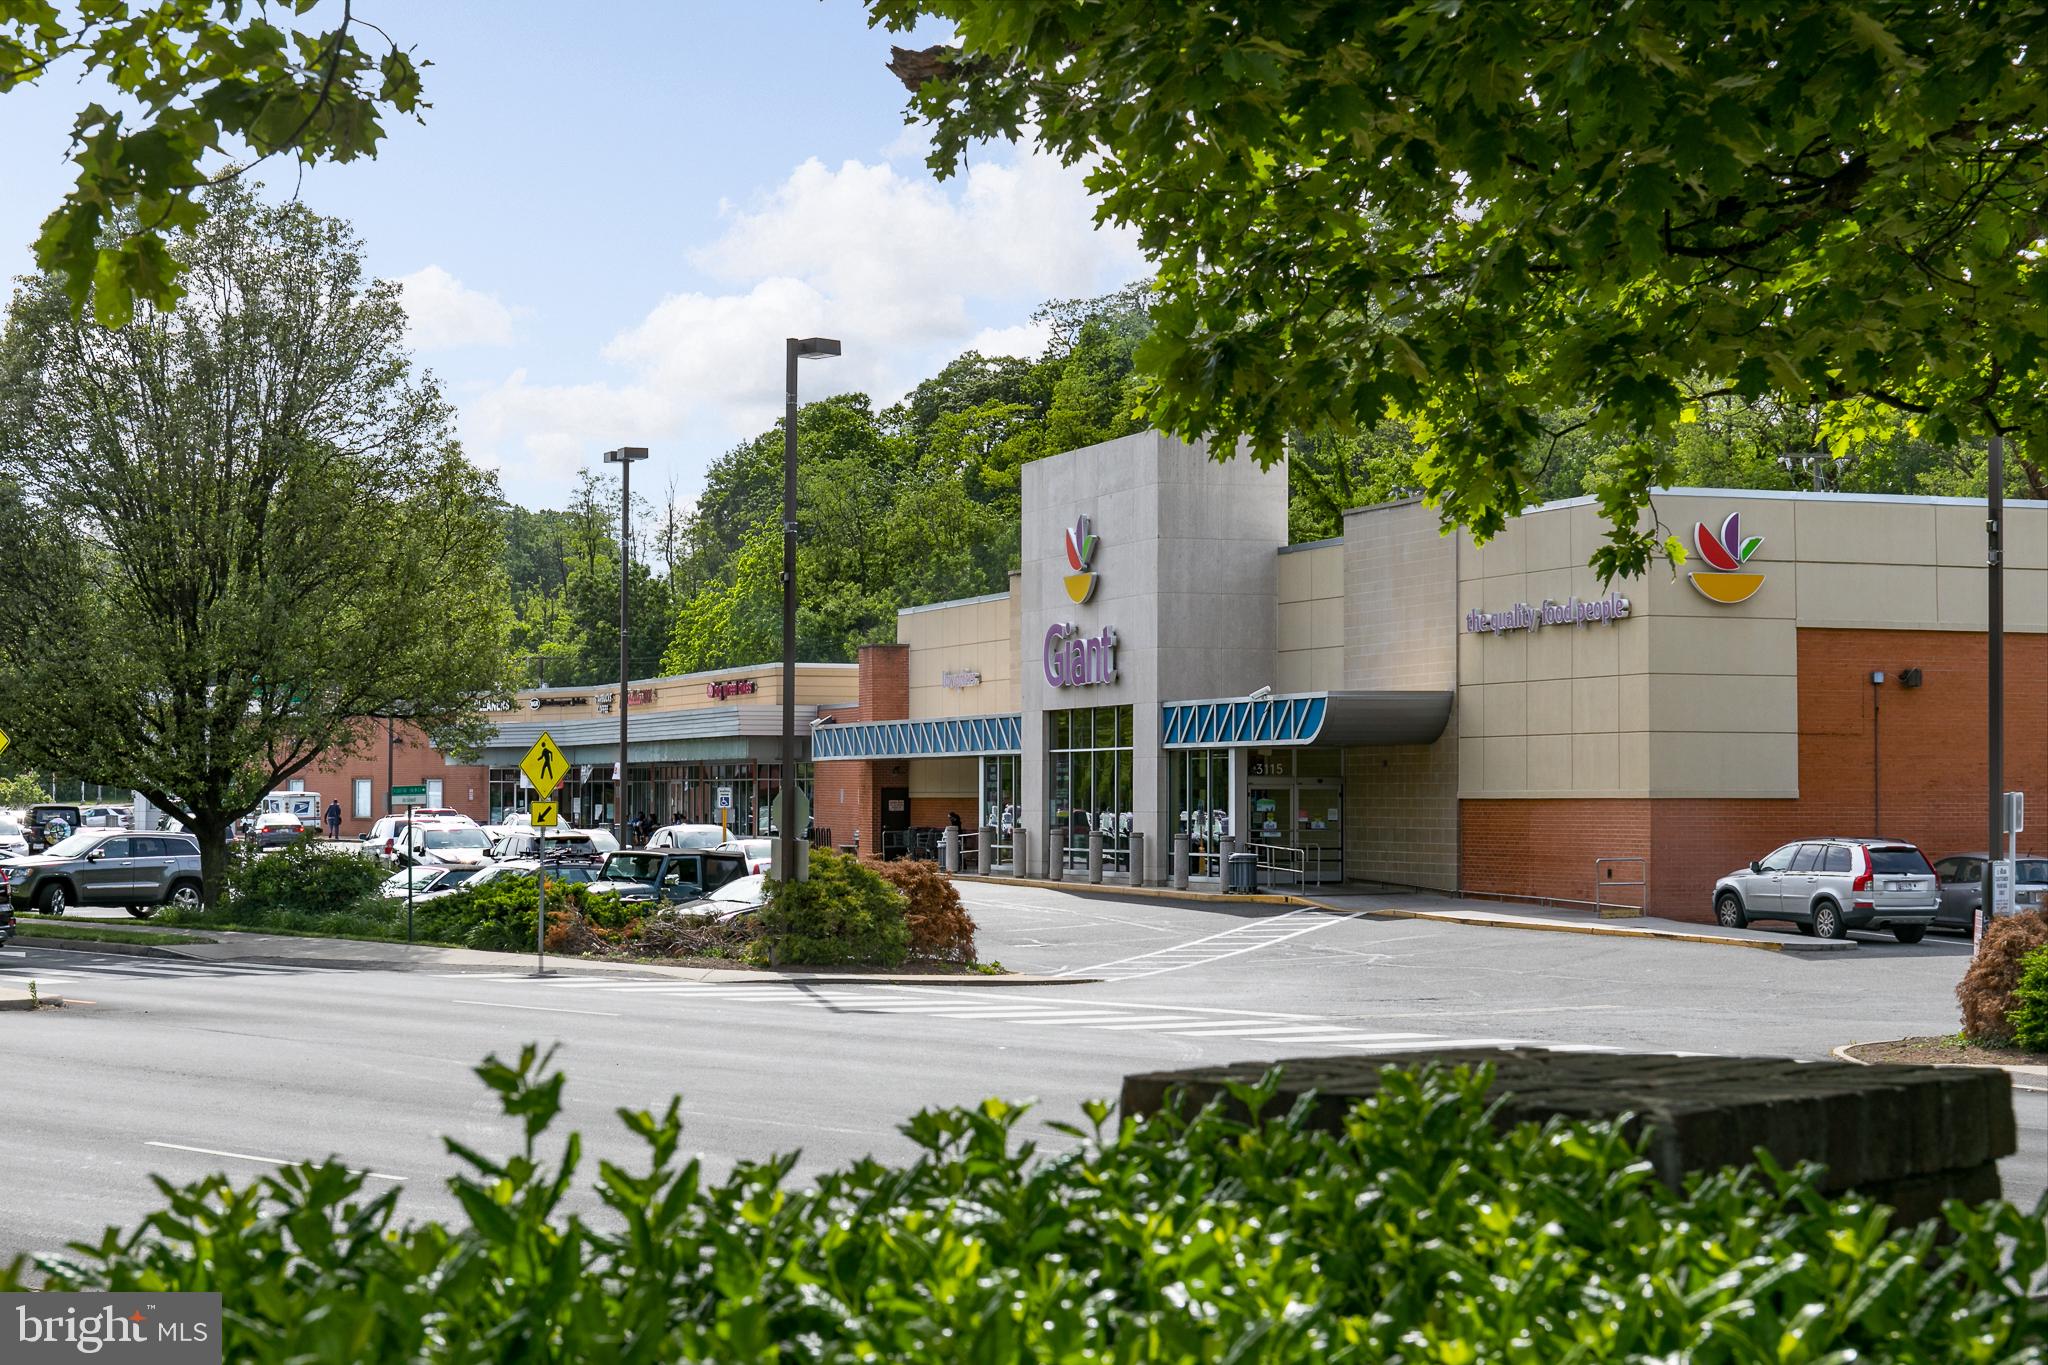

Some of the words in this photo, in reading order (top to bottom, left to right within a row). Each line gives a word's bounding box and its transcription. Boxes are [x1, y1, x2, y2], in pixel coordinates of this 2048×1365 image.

[1466, 608, 1488, 632] the
[1489, 602, 1536, 636] quality
[1541, 597, 1573, 625] food
[1576, 592, 1625, 628] people
[1043, 622, 1113, 689] Giant
[1256, 763, 1283, 775] 3115
